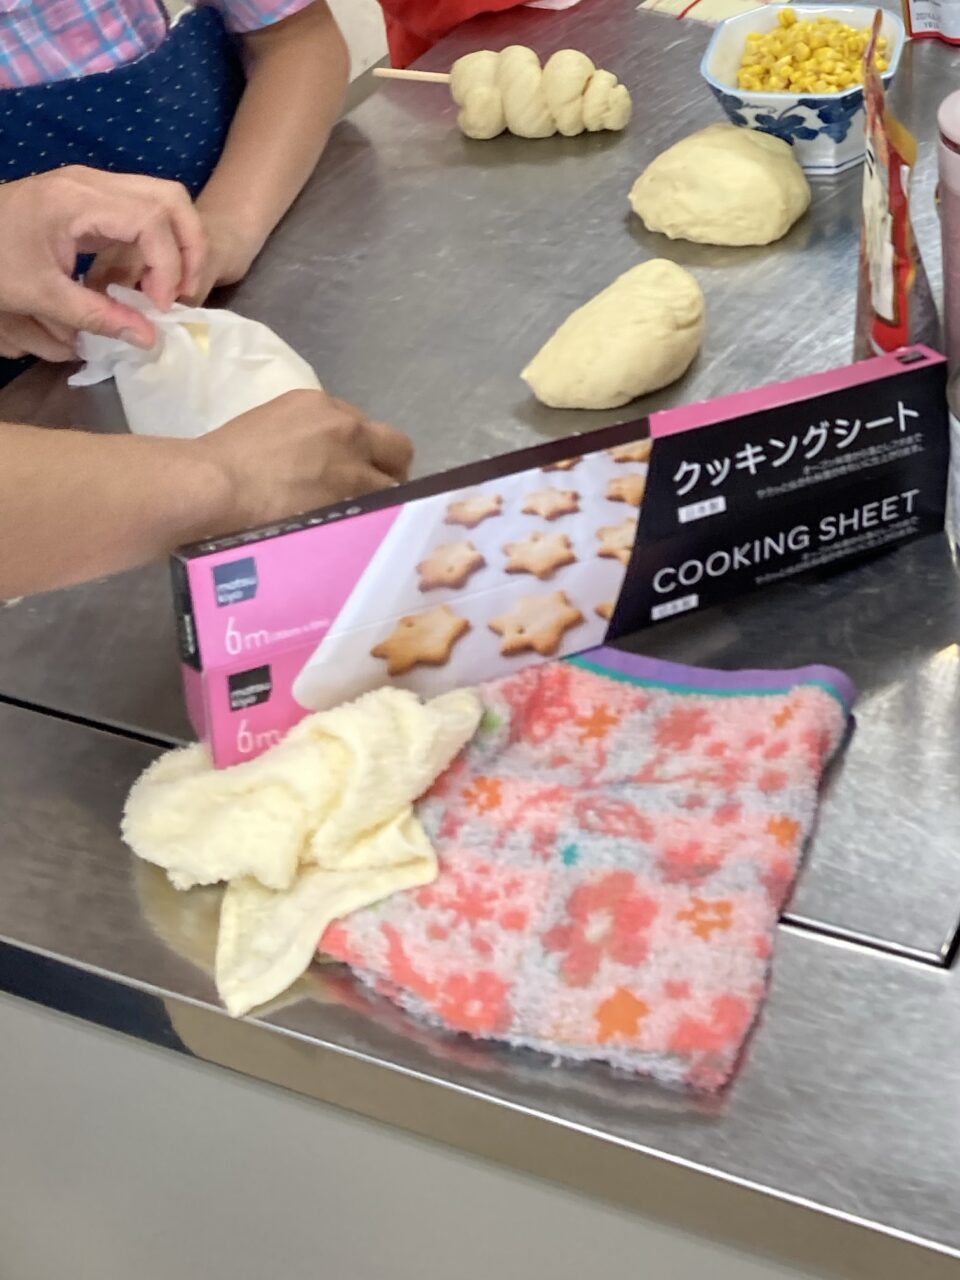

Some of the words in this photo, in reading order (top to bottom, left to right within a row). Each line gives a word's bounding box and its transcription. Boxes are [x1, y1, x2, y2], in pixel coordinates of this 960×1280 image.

[672, 401, 919, 496] クッキングシート
[653, 525, 810, 594] COOKING
[819, 489, 919, 542] SHEET
[225, 617, 270, 655] 6m
